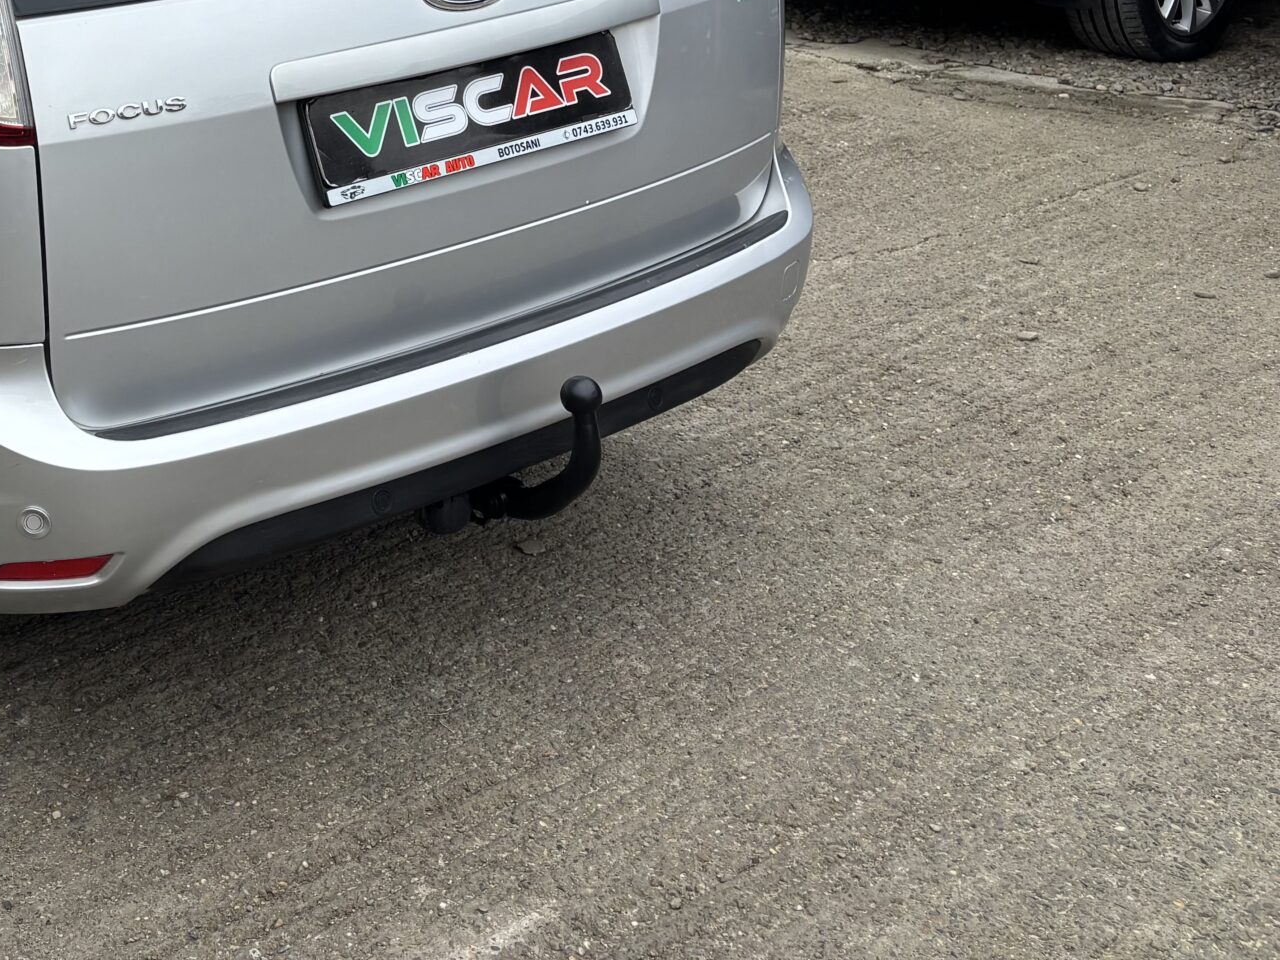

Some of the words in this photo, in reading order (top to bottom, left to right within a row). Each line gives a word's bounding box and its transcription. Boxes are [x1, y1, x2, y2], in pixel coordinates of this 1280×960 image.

[67, 96, 187, 130] FOCUS
[329, 52, 612, 158] VISCAR
[391, 164, 441, 187] VISCAR
[445, 154, 475, 174] AUTO
[497, 138, 541, 158] BOTOSANI
[571, 114, 628, 138] 0743.639.931
